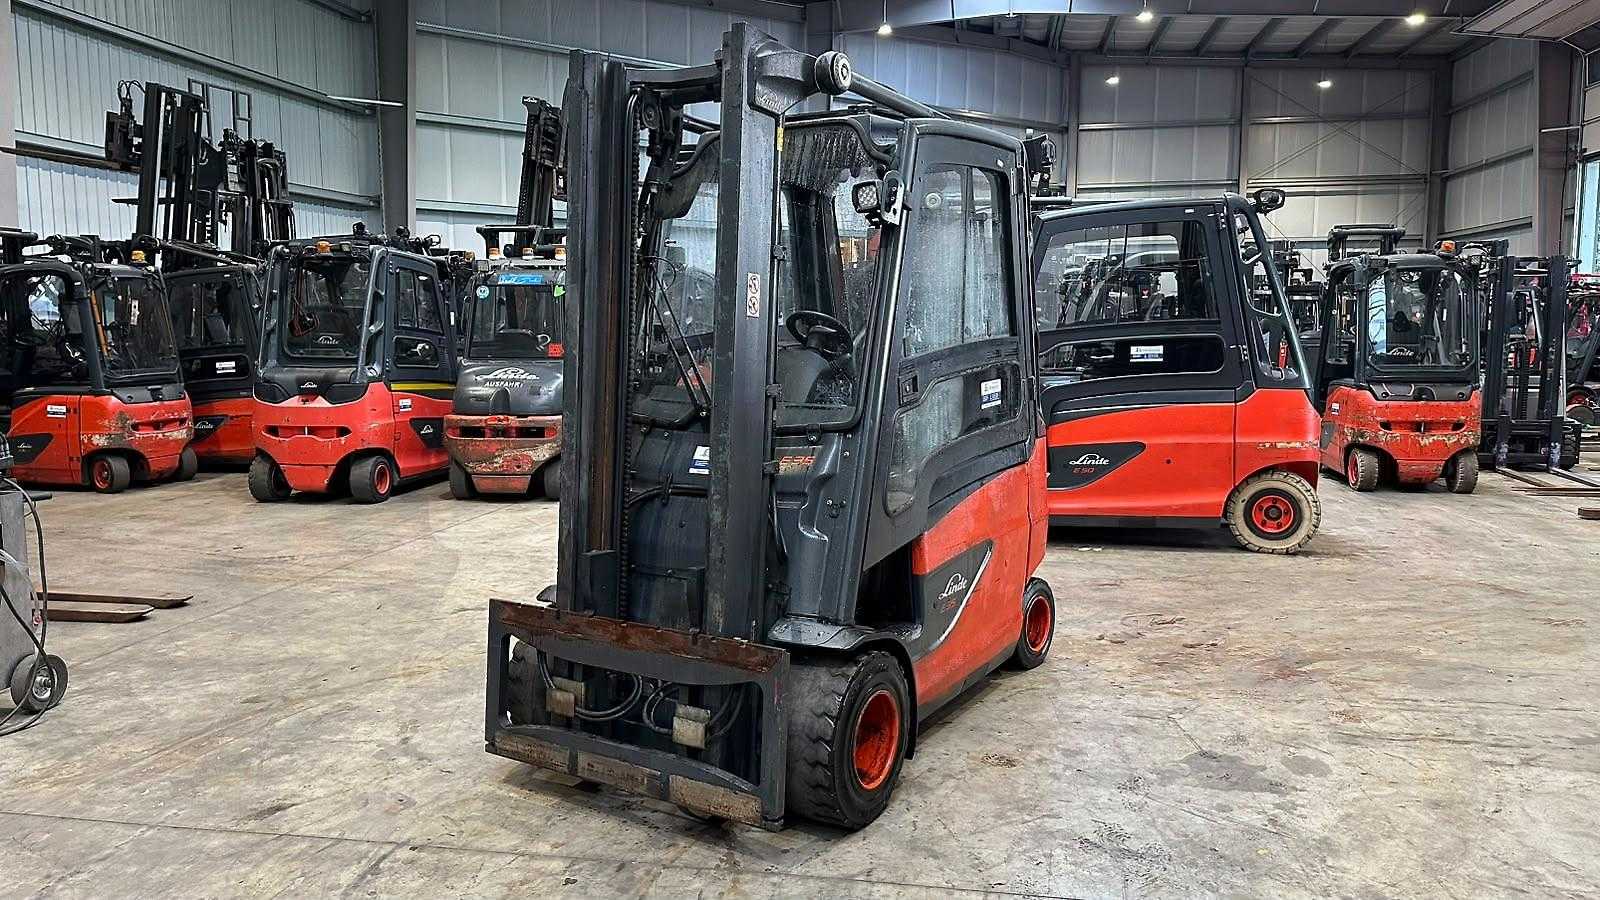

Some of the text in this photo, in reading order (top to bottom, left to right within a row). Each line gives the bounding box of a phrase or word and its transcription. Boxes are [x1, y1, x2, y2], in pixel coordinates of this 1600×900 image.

[473, 367, 540, 381] Linde
[1069, 453, 1110, 465] Linde
[938, 572, 968, 600] Linde
